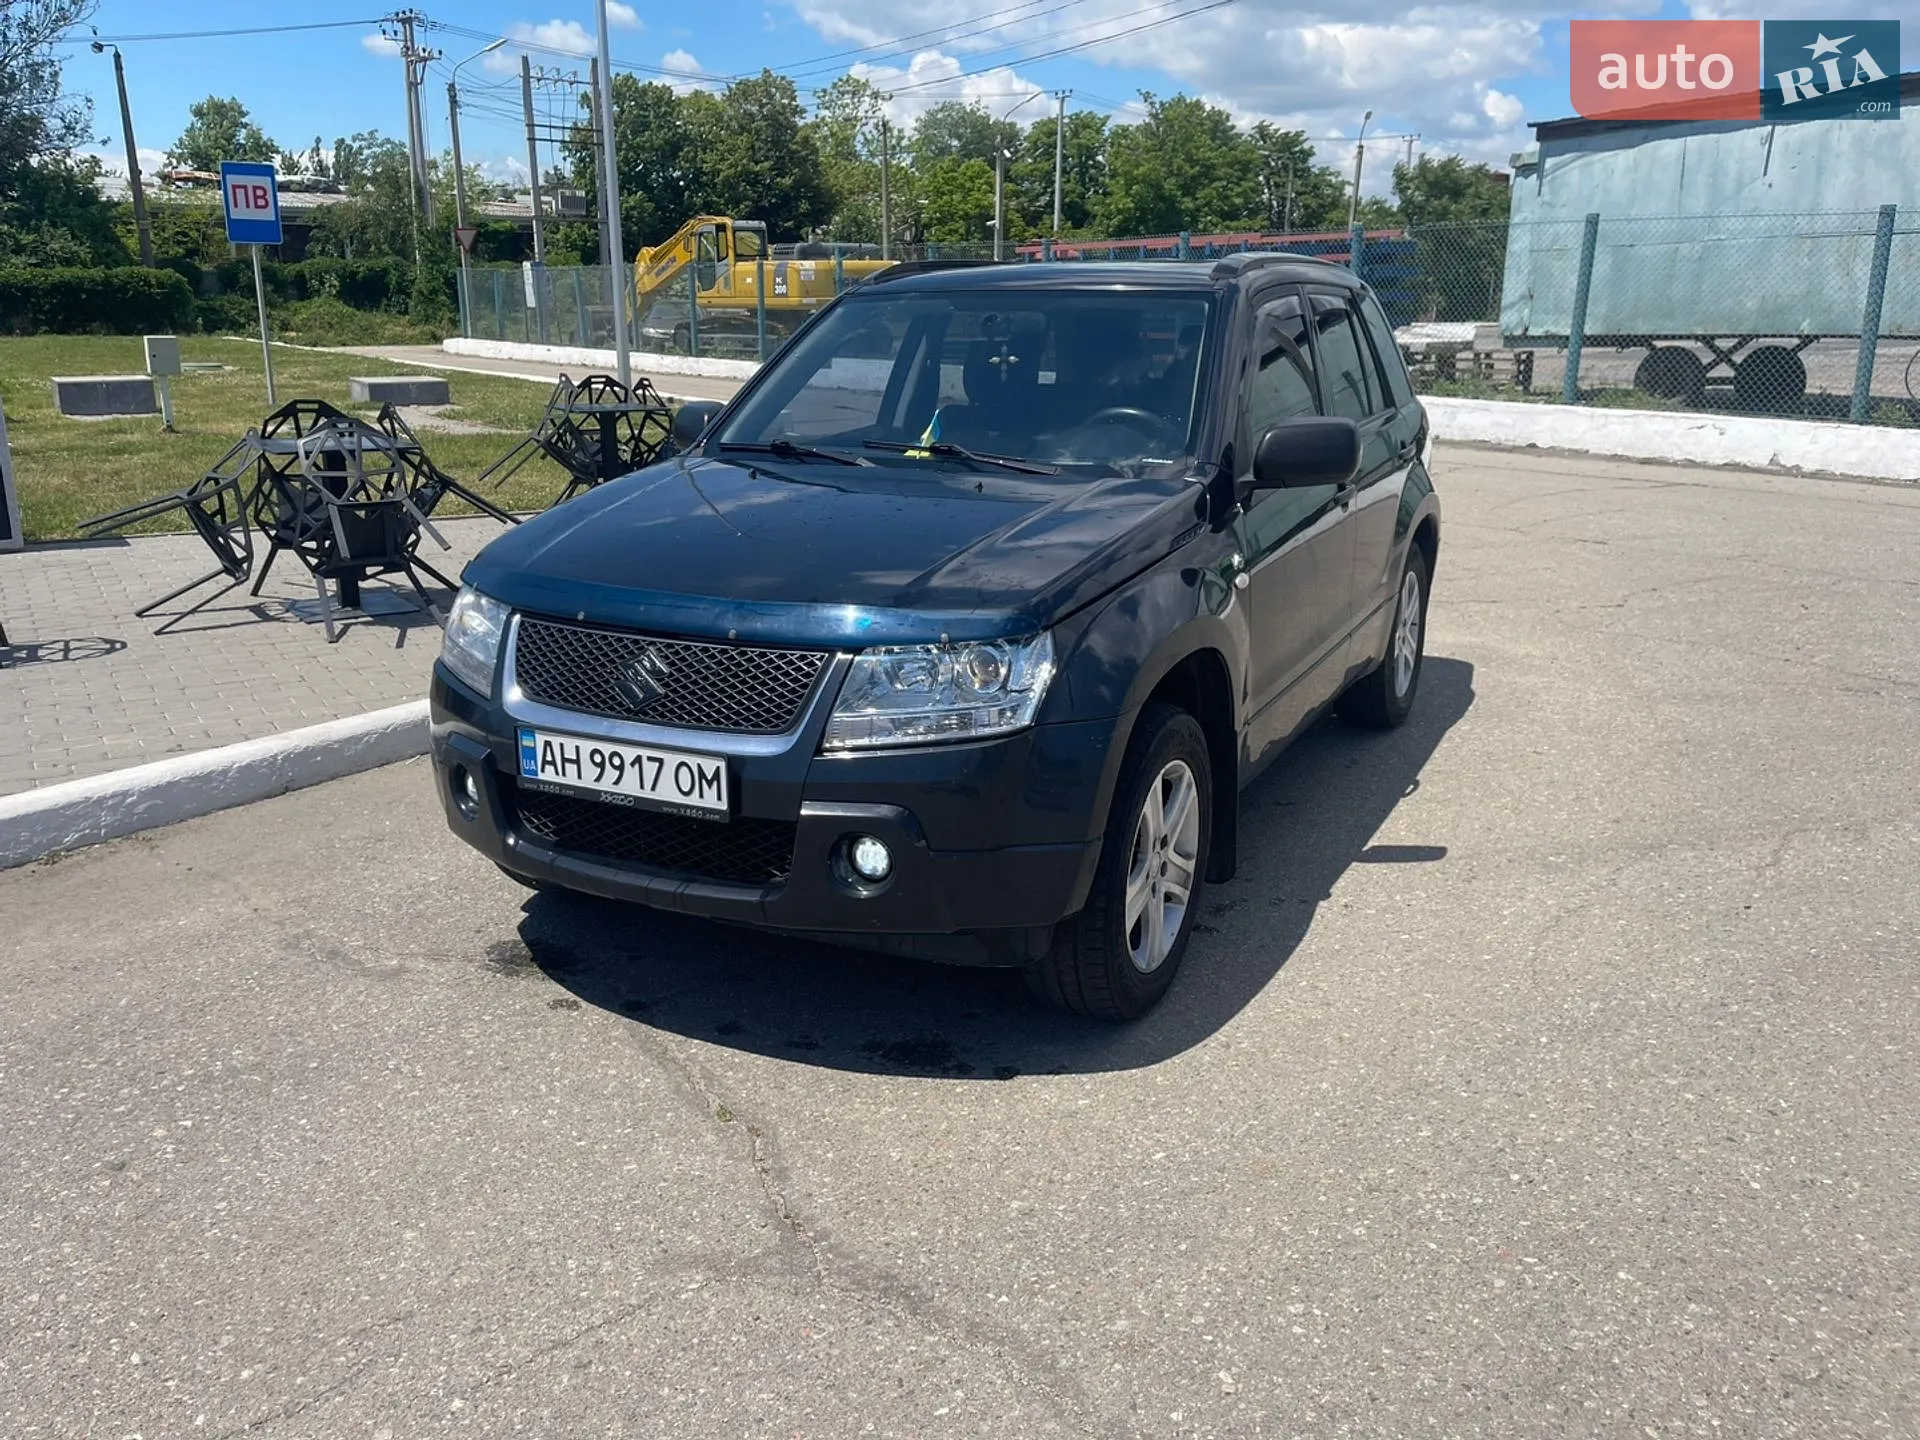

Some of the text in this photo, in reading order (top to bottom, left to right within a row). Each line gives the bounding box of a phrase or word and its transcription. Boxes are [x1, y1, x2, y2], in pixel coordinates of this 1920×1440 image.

[231, 184, 270, 209] ПВ
[523, 759, 536, 770] UA
[540, 739, 722, 802] AH 9917 OM
